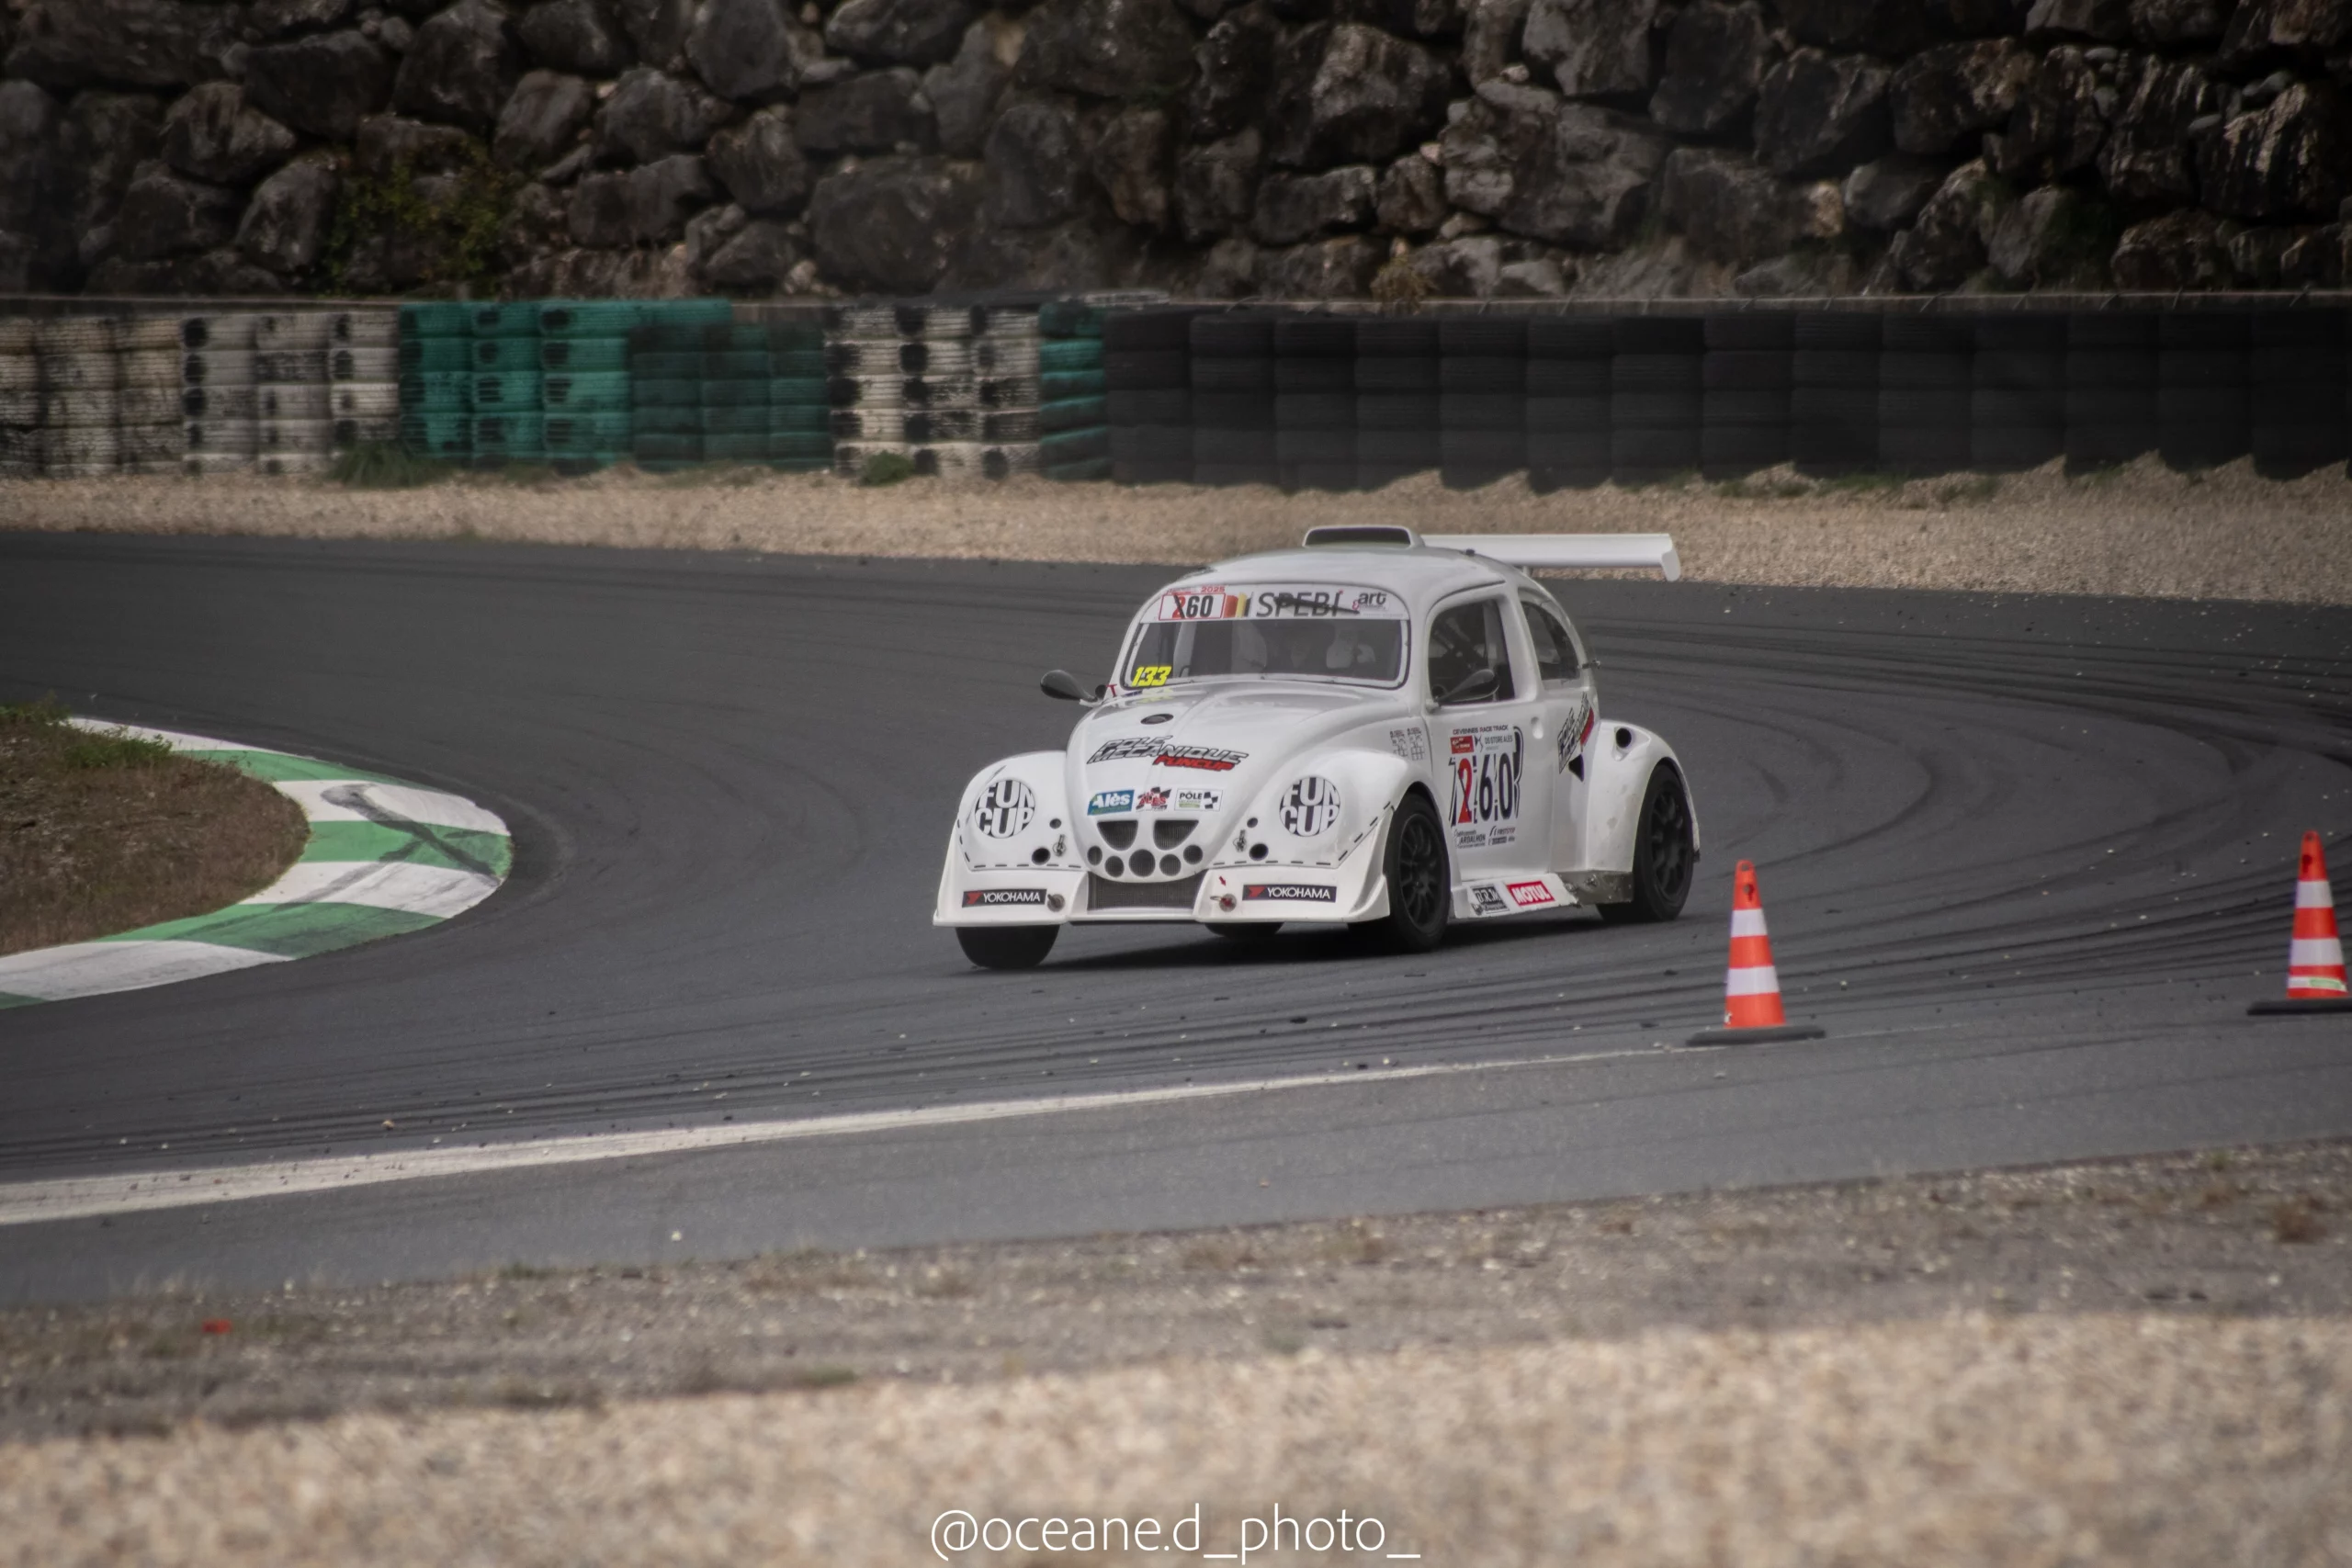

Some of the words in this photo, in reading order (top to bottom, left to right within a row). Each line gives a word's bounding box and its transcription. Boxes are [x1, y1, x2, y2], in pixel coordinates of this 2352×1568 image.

[1131, 665, 1172, 687] 133
[978, 780, 1035, 808] FUN
[1091, 792, 1131, 808] Alès
[1283, 777, 1341, 806] FUN
[975, 807, 1034, 839] CUP
[1280, 805, 1340, 837] CUP
[983, 891, 1041, 904] YOKOHAMA
[1267, 886, 1331, 899] YOKOHAMA
[1510, 884, 1552, 905] MOTUL
